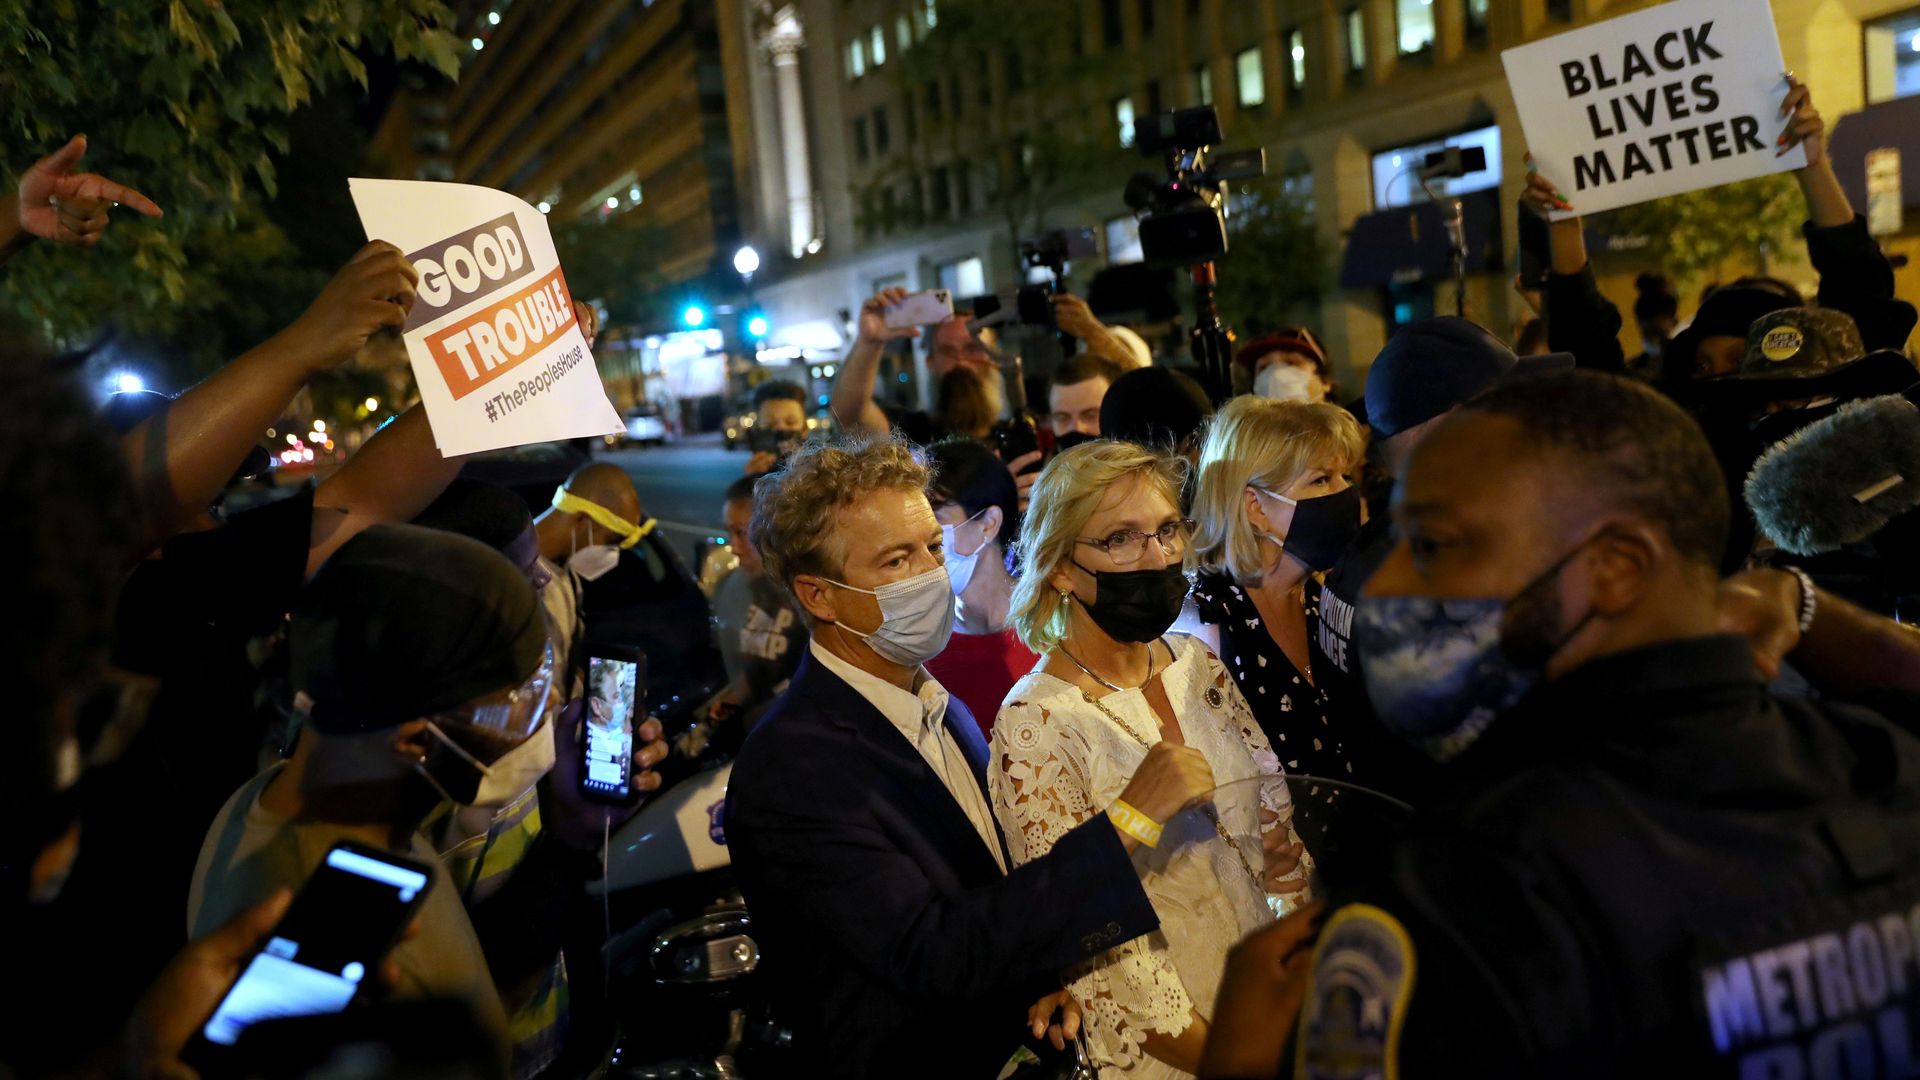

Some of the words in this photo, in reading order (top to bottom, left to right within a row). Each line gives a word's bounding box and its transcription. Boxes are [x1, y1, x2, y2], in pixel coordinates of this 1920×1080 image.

[1559, 20, 1724, 98] BLACK
[1586, 74, 1720, 140] LIVES
[1572, 114, 1767, 192] MATTER
[412, 224, 524, 308] GOOD
[441, 278, 572, 382] TROUBLE
[484, 344, 584, 423] #ThePeoplesHouse
[1702, 901, 1920, 1056] METROP
